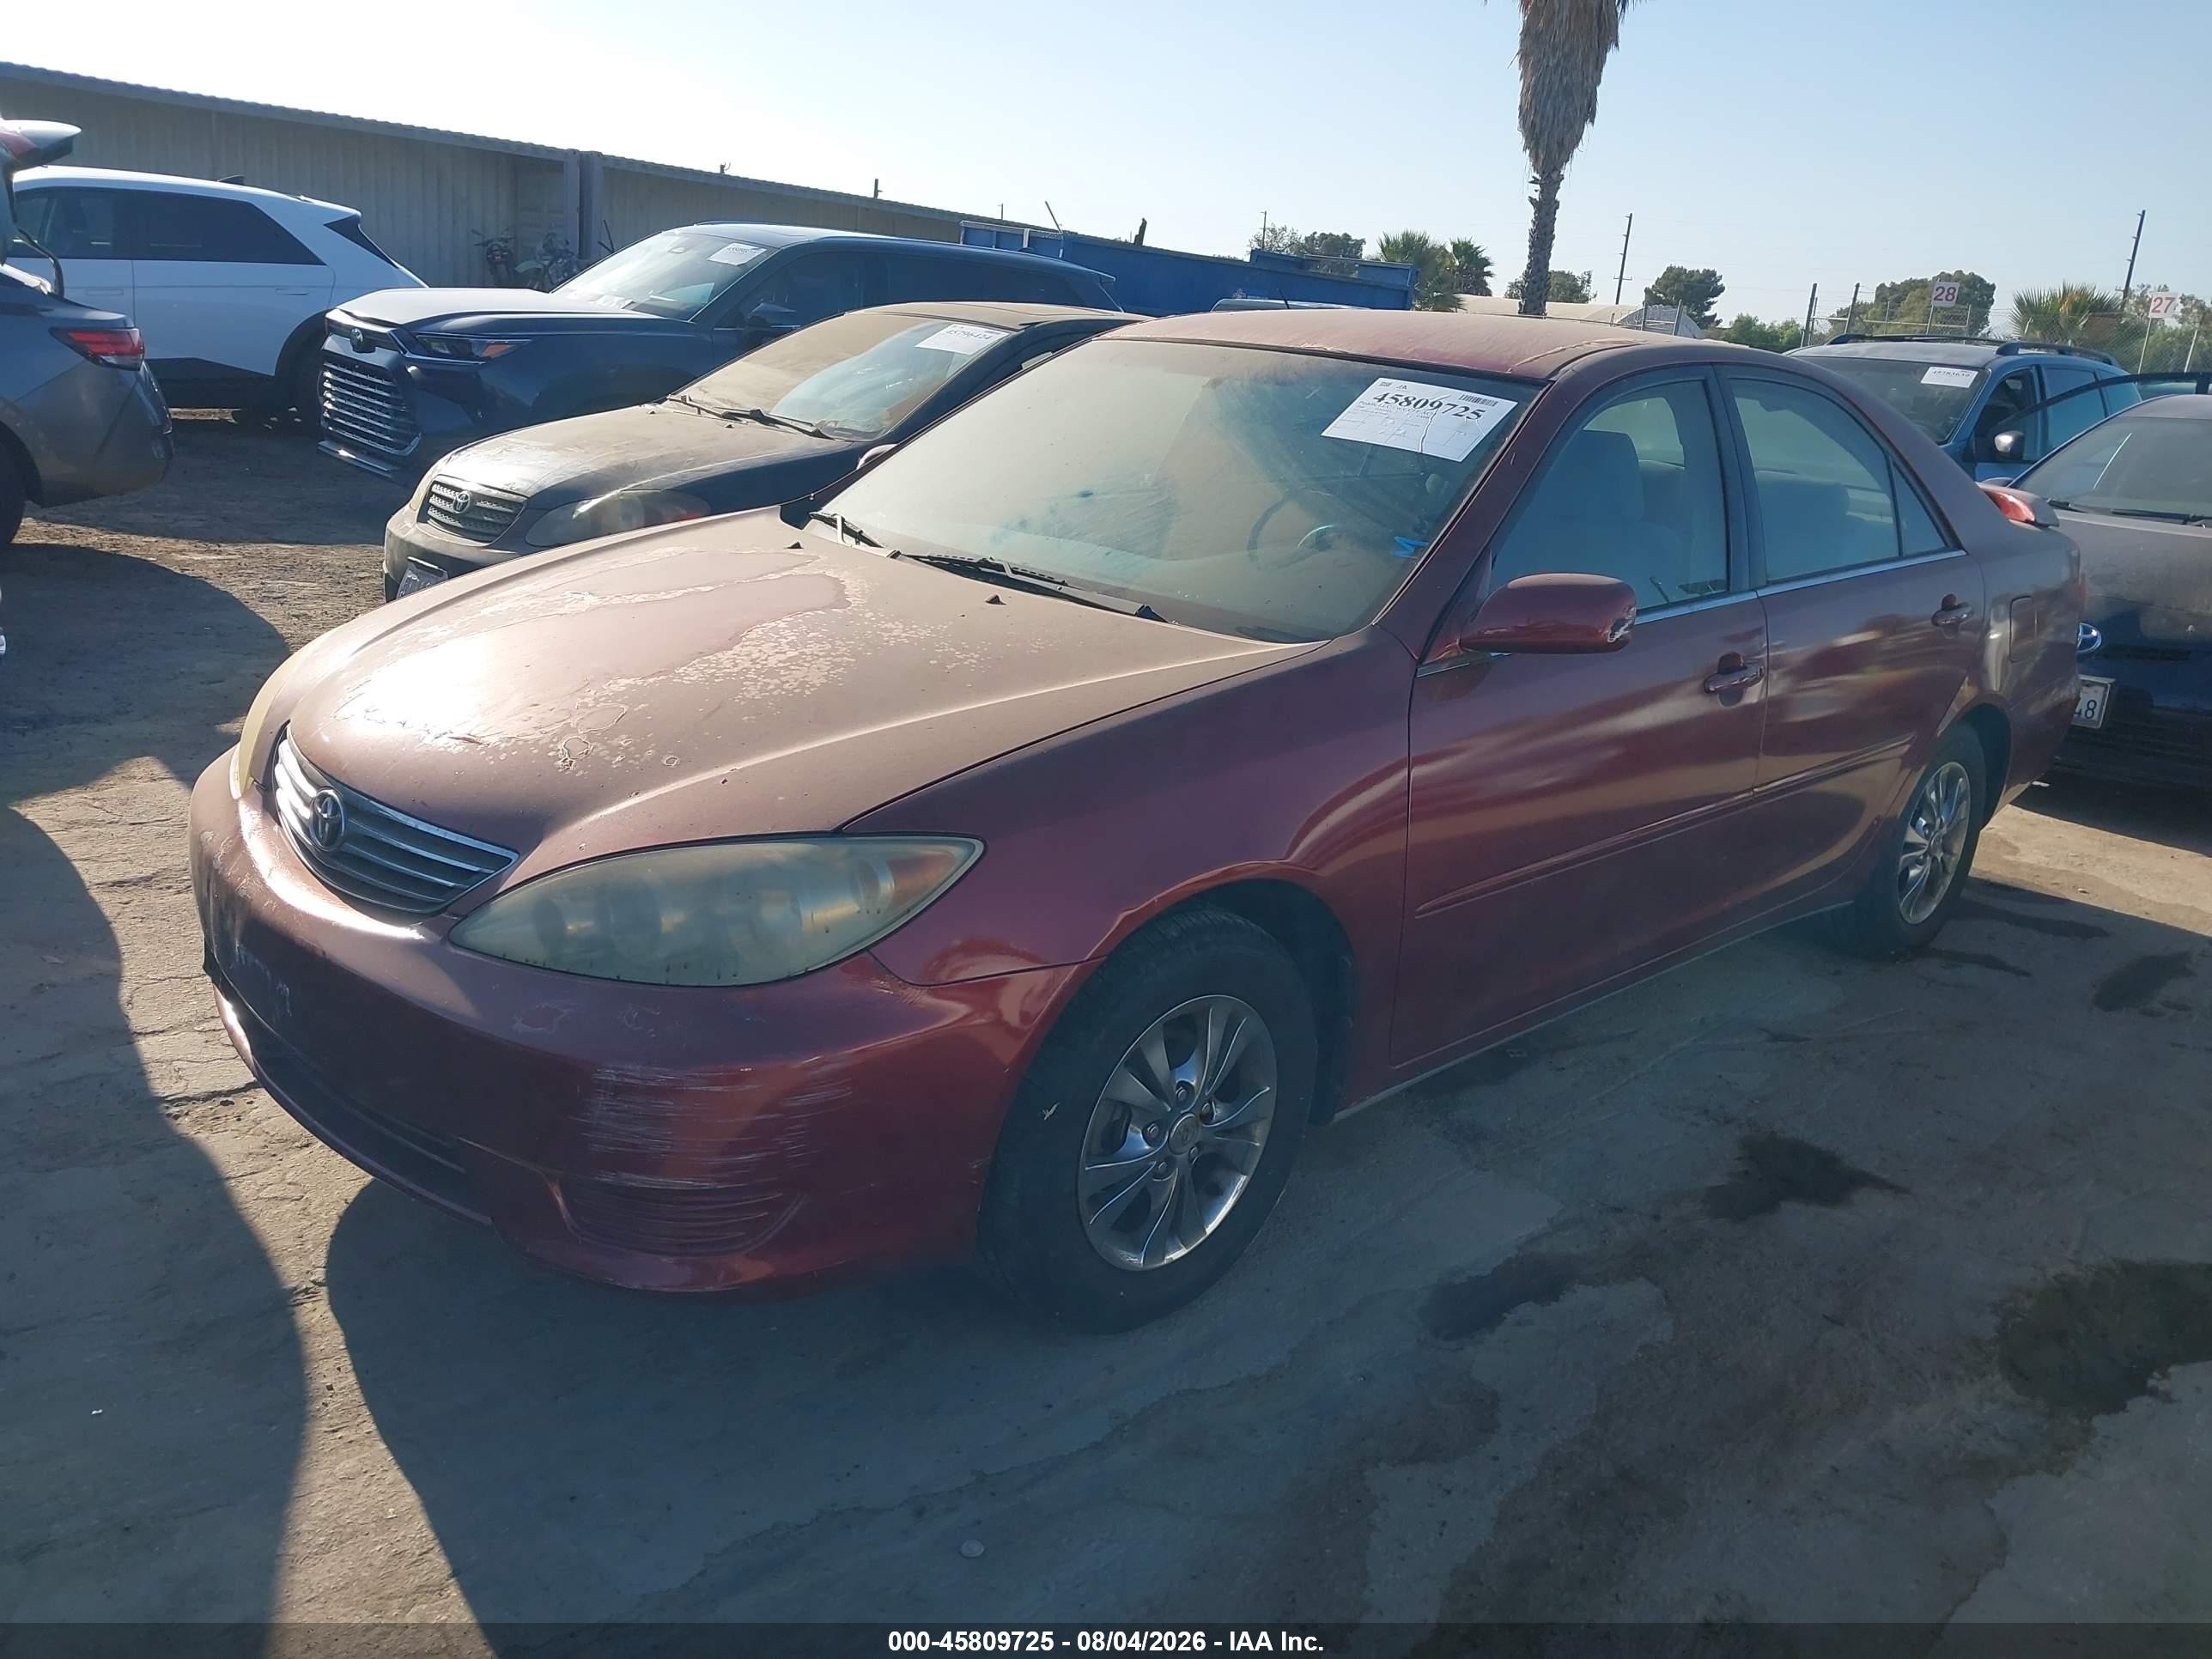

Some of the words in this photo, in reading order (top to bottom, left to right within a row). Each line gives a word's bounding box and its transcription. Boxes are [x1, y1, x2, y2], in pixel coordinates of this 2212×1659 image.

[1933, 286, 1957, 302] 28
[2151, 296, 2176, 313] 27
[1373, 392, 1486, 420] 45809725
